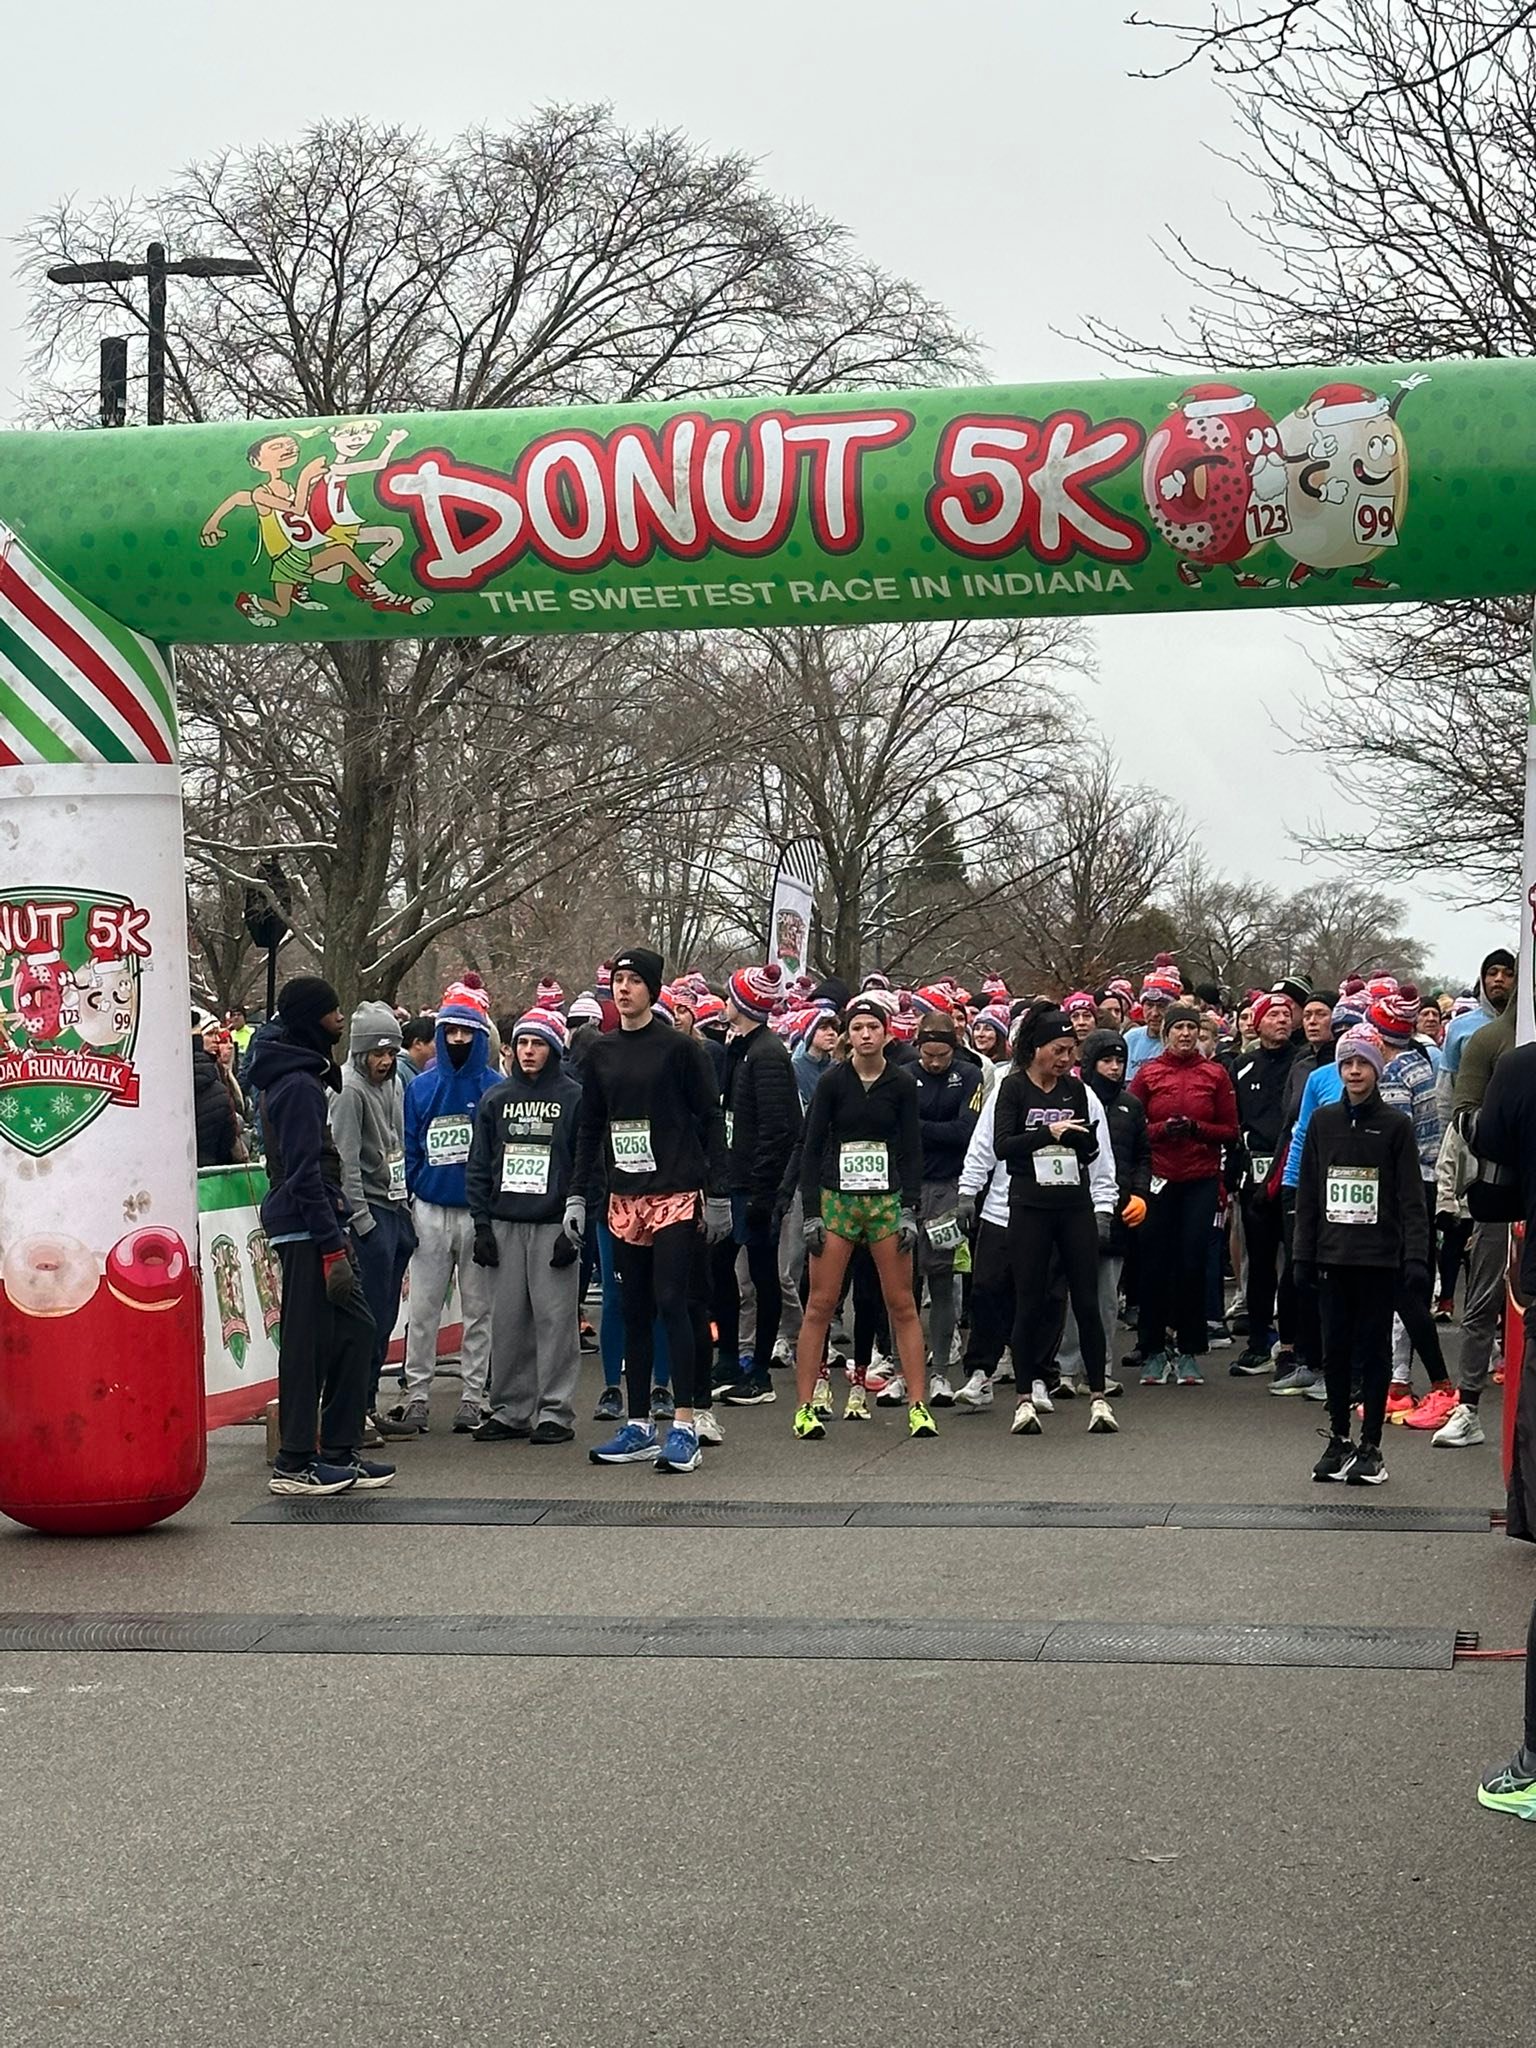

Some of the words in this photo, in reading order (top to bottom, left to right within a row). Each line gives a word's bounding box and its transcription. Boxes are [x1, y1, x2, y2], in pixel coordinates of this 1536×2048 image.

[385, 417, 898, 580] DONUT
[940, 421, 1134, 552] 5K
[282, 511, 313, 542] 5
[1247, 504, 1289, 538] 123
[1357, 504, 1394, 541] 99
[480, 590, 561, 614] THE
[568, 581, 776, 612] SWEETEST
[788, 577, 900, 603] RACE
[910, 575, 951, 599] IN
[962, 568, 1134, 597] INDIANA
[90, 908, 149, 953] 5K
[61, 1009, 80, 1026] 123
[113, 1012, 131, 1031] 99
[28, 1059, 123, 1086] RUN/WALK
[502, 1101, 562, 1119] HAWKS
[430, 1127, 471, 1150] 5229
[614, 1135, 648, 1155] 5253
[506, 1158, 546, 1177] 5232
[843, 1155, 885, 1173] 5339
[1052, 1158, 1064, 1176] 3
[1330, 1182, 1375, 1205] 6166
